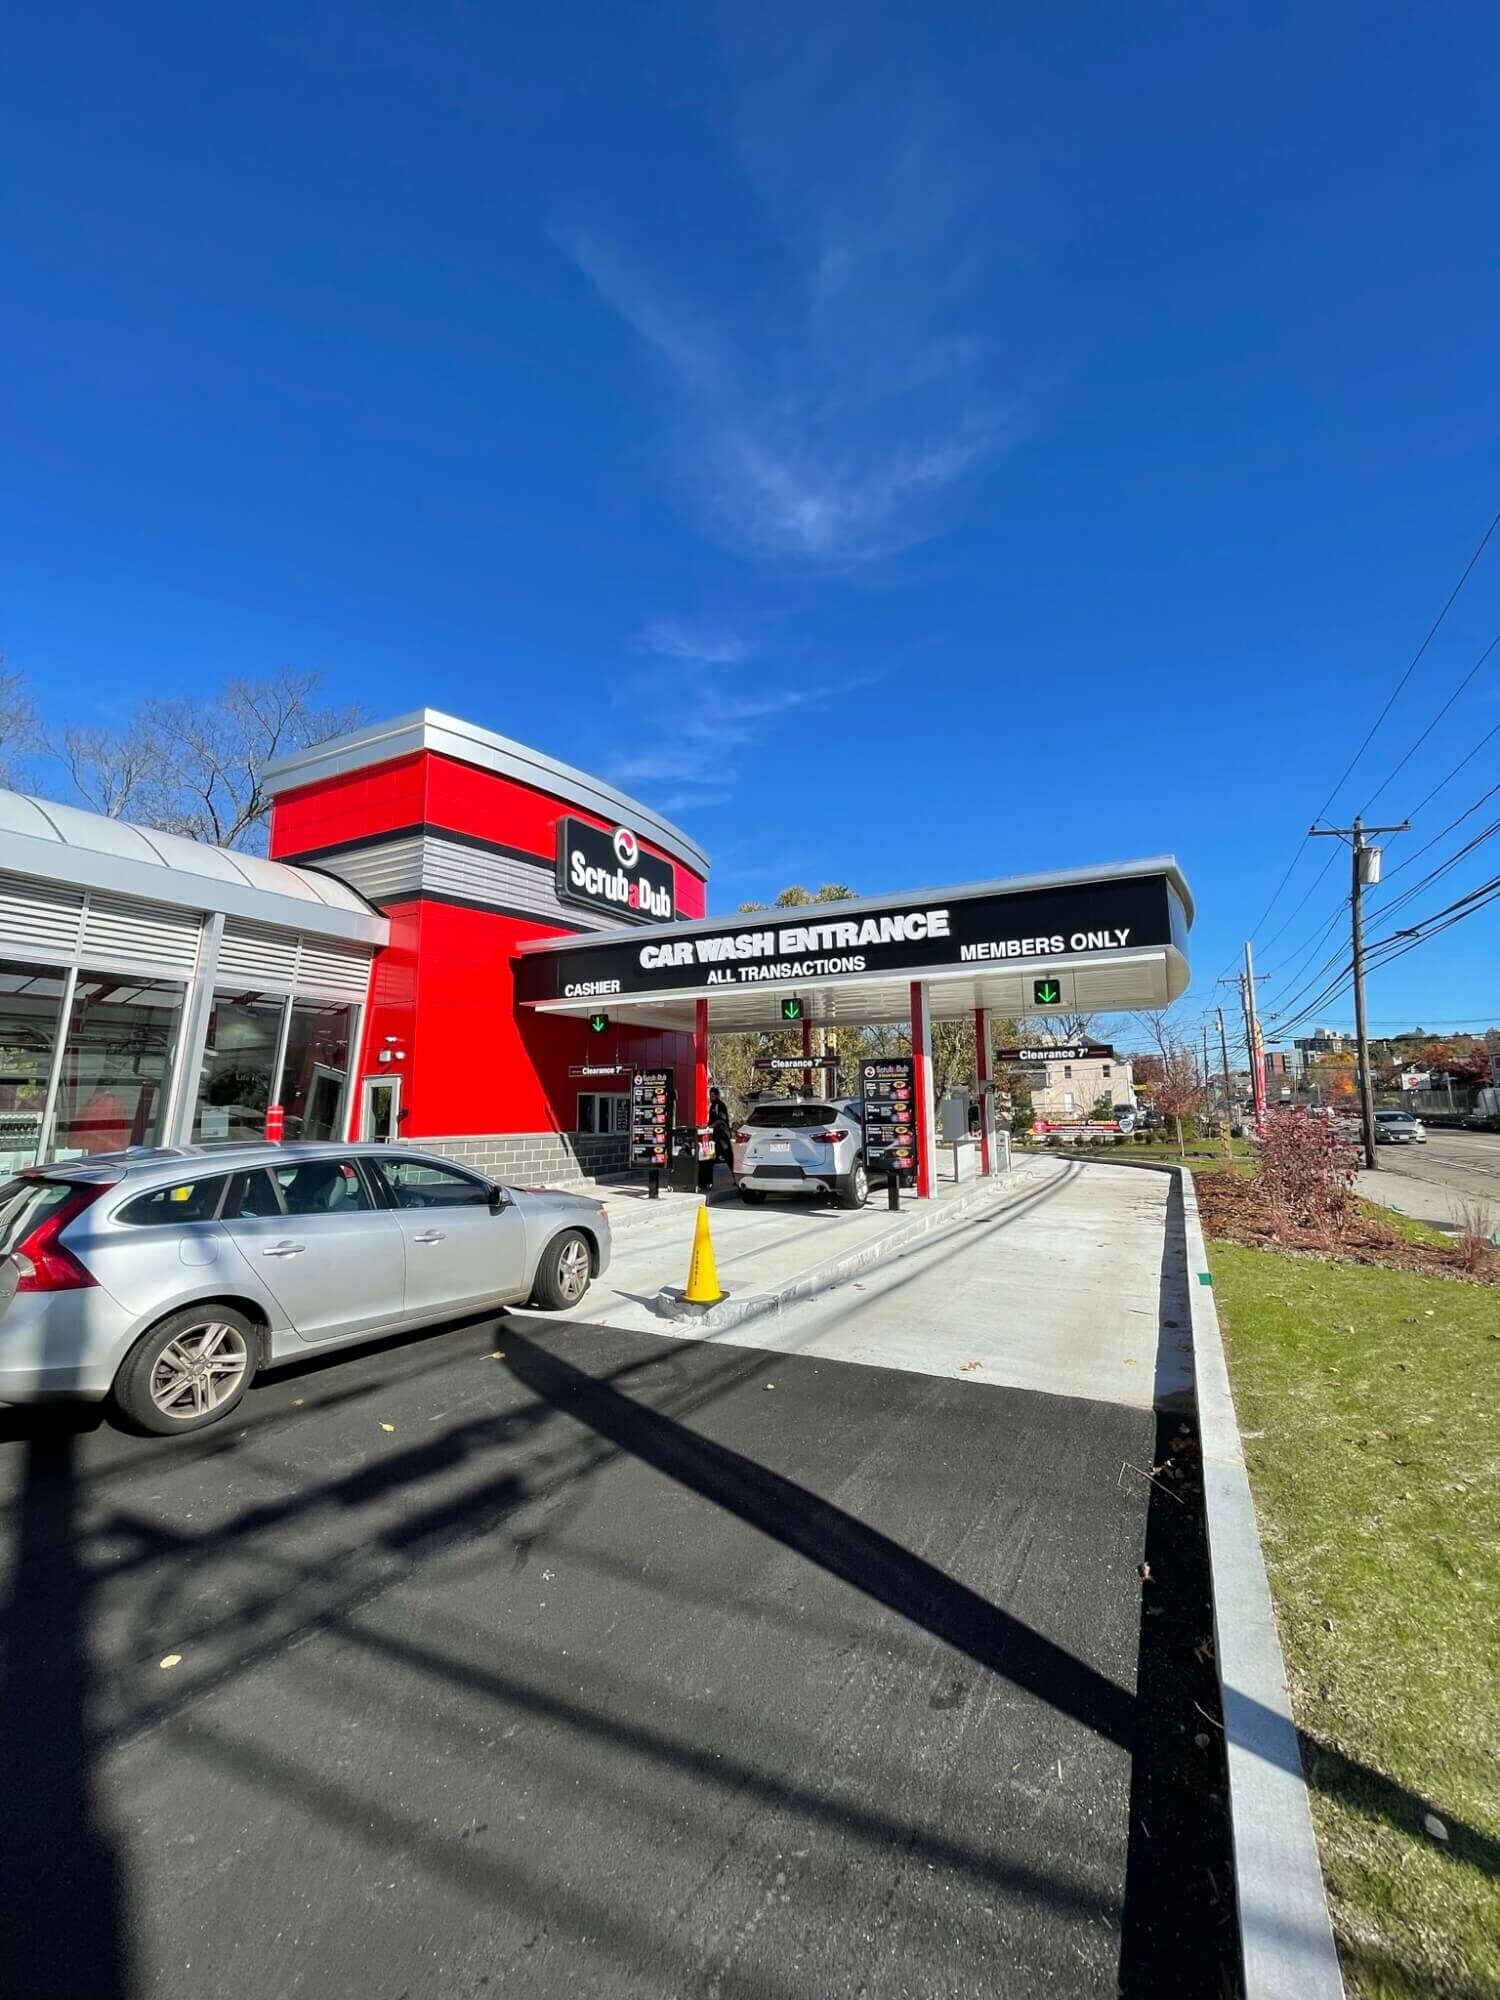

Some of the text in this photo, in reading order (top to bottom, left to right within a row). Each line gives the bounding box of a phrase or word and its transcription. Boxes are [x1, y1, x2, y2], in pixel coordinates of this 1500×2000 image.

[640, 909, 950, 969] CAR WASH ENTRANCE
[960, 928, 1130, 961] MEMBERS ONLY
[707, 955, 866, 985] ALL TRANSACTIONS
[564, 979, 621, 997] CASHIER
[1019, 1048, 1089, 1060] Clearance 7'
[582, 1067, 615, 1075] Clearance
[771, 1059, 813, 1068] Clearance
